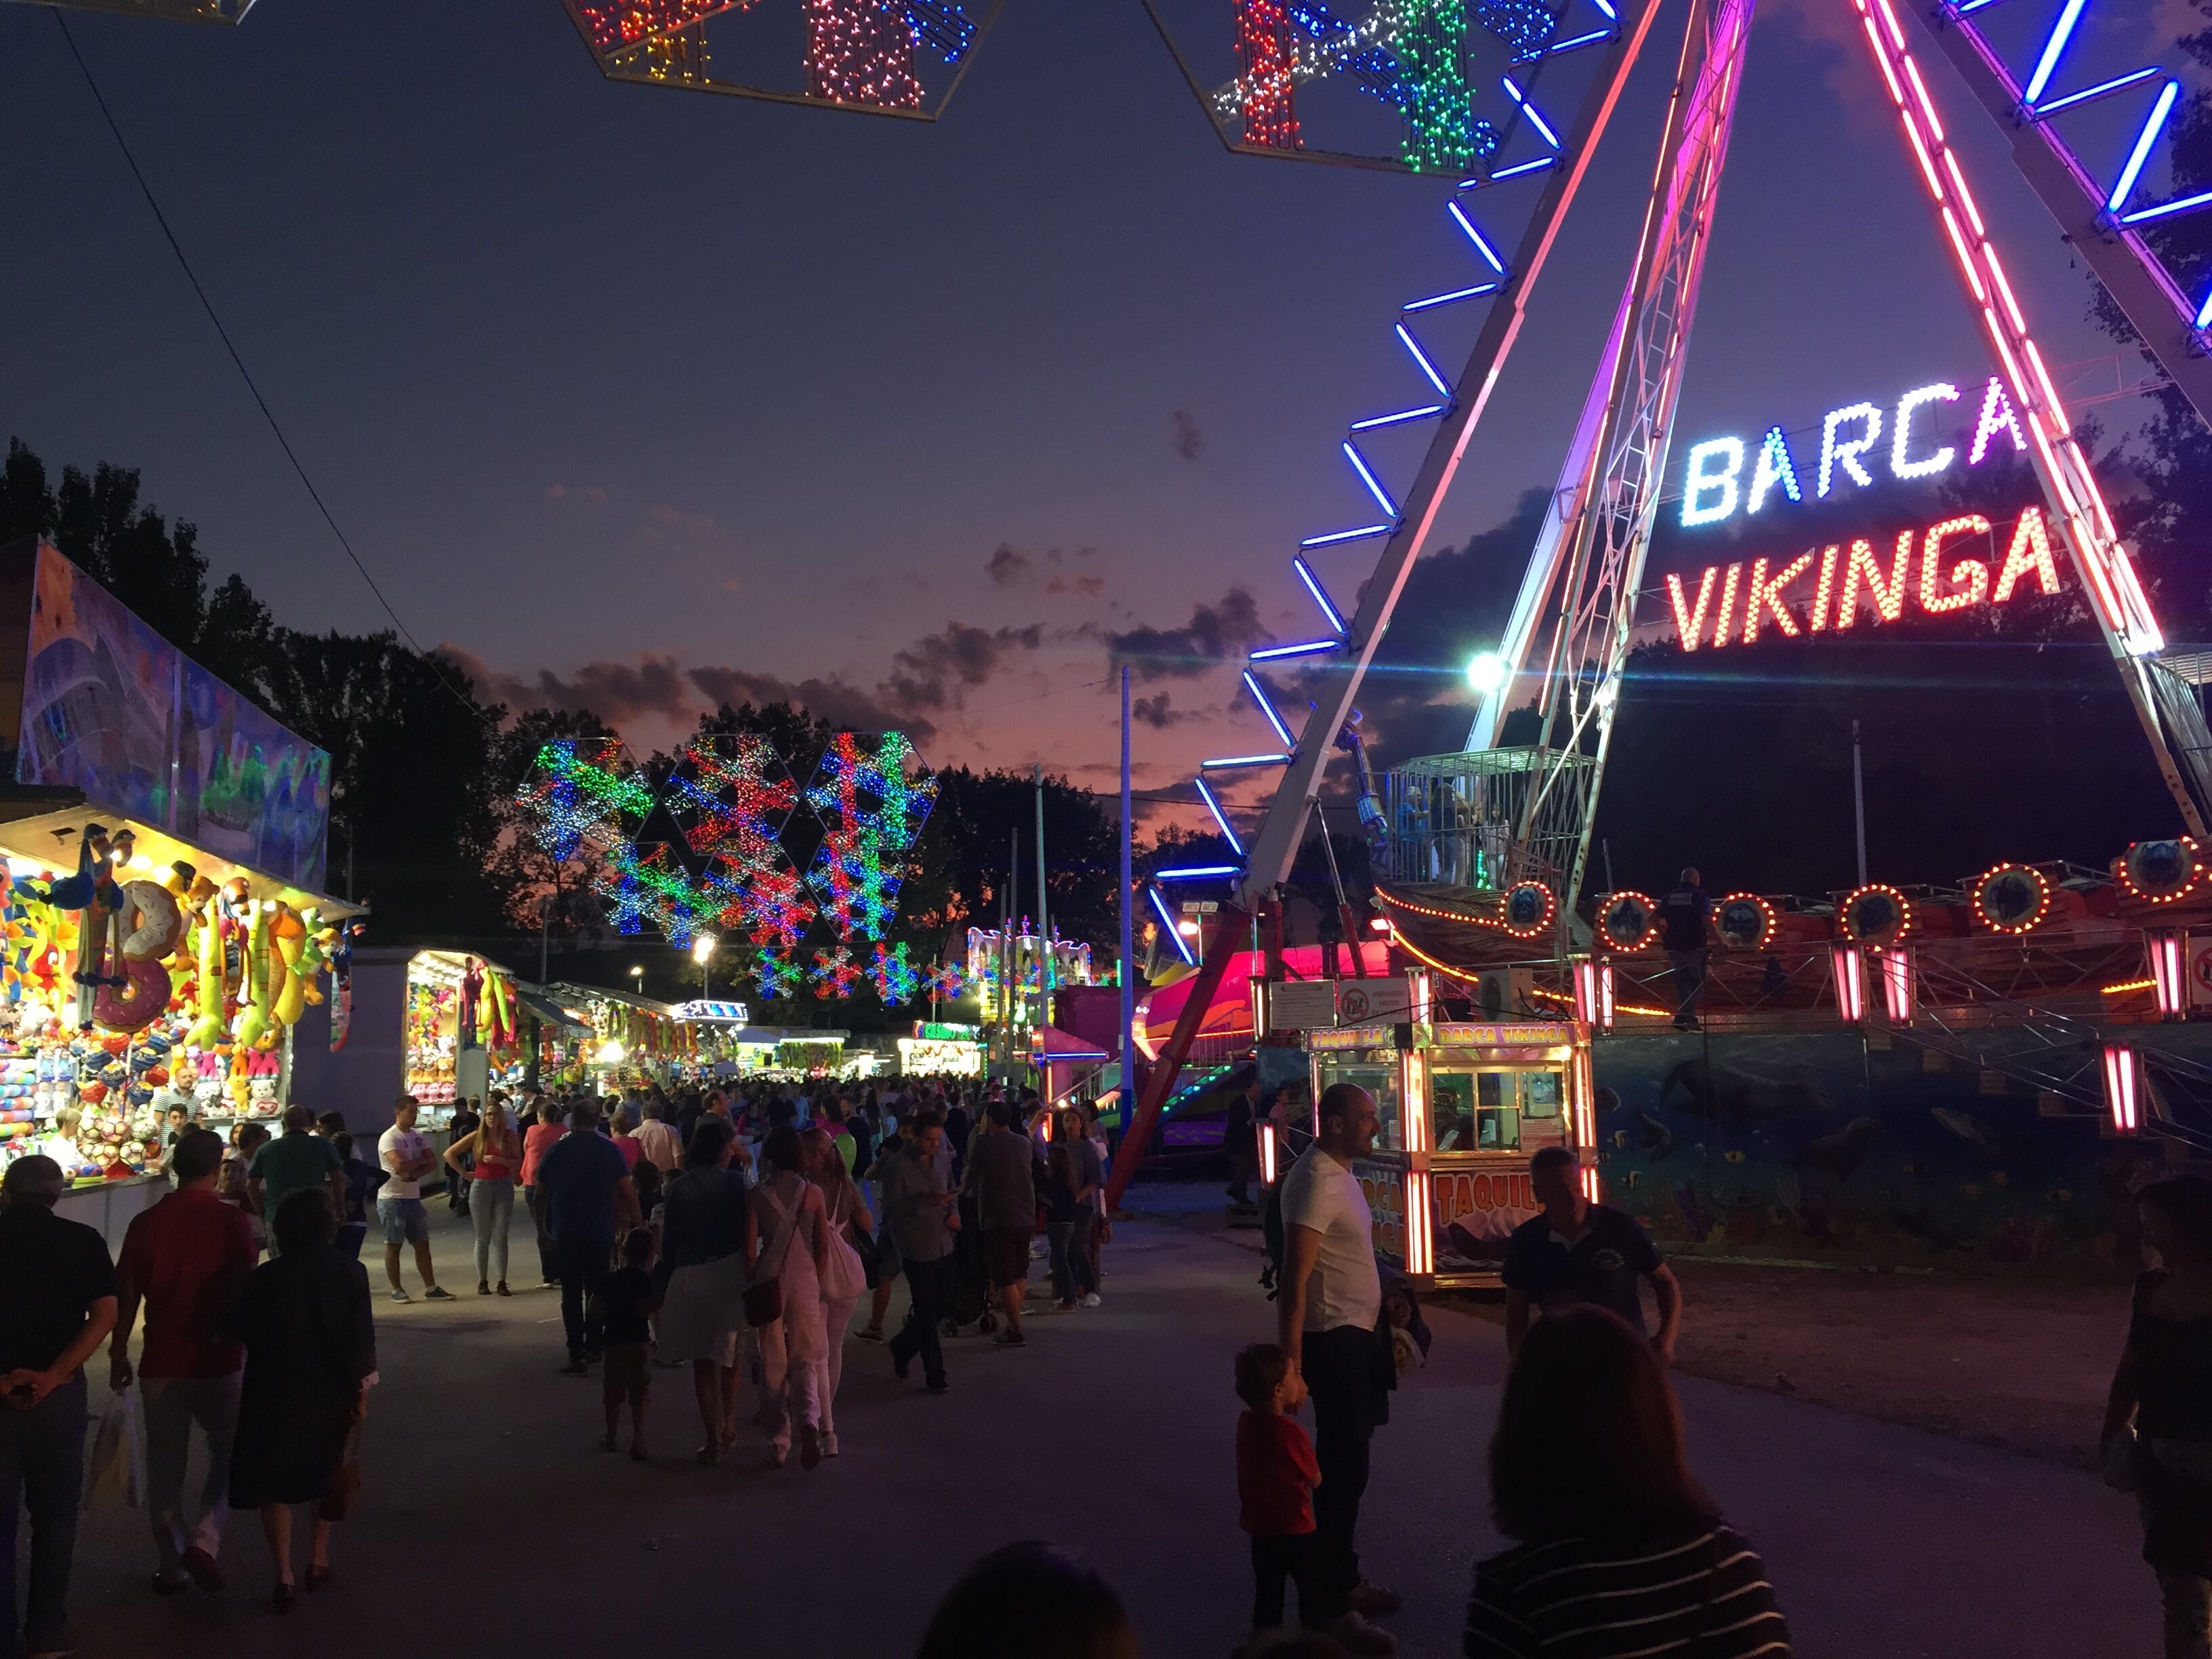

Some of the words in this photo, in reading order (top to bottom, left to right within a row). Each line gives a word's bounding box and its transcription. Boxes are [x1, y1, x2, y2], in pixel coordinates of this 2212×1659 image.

[1680, 376, 2028, 527] BARCA
[1666, 506, 2061, 652] VIKINGA
[1311, 1028, 1384, 1048] TAQUILLA
[1439, 1027, 1497, 1043] BARCA
[1501, 1027, 1569, 1043] VIKINGA
[1435, 1174, 1545, 1227] TAQUIL
